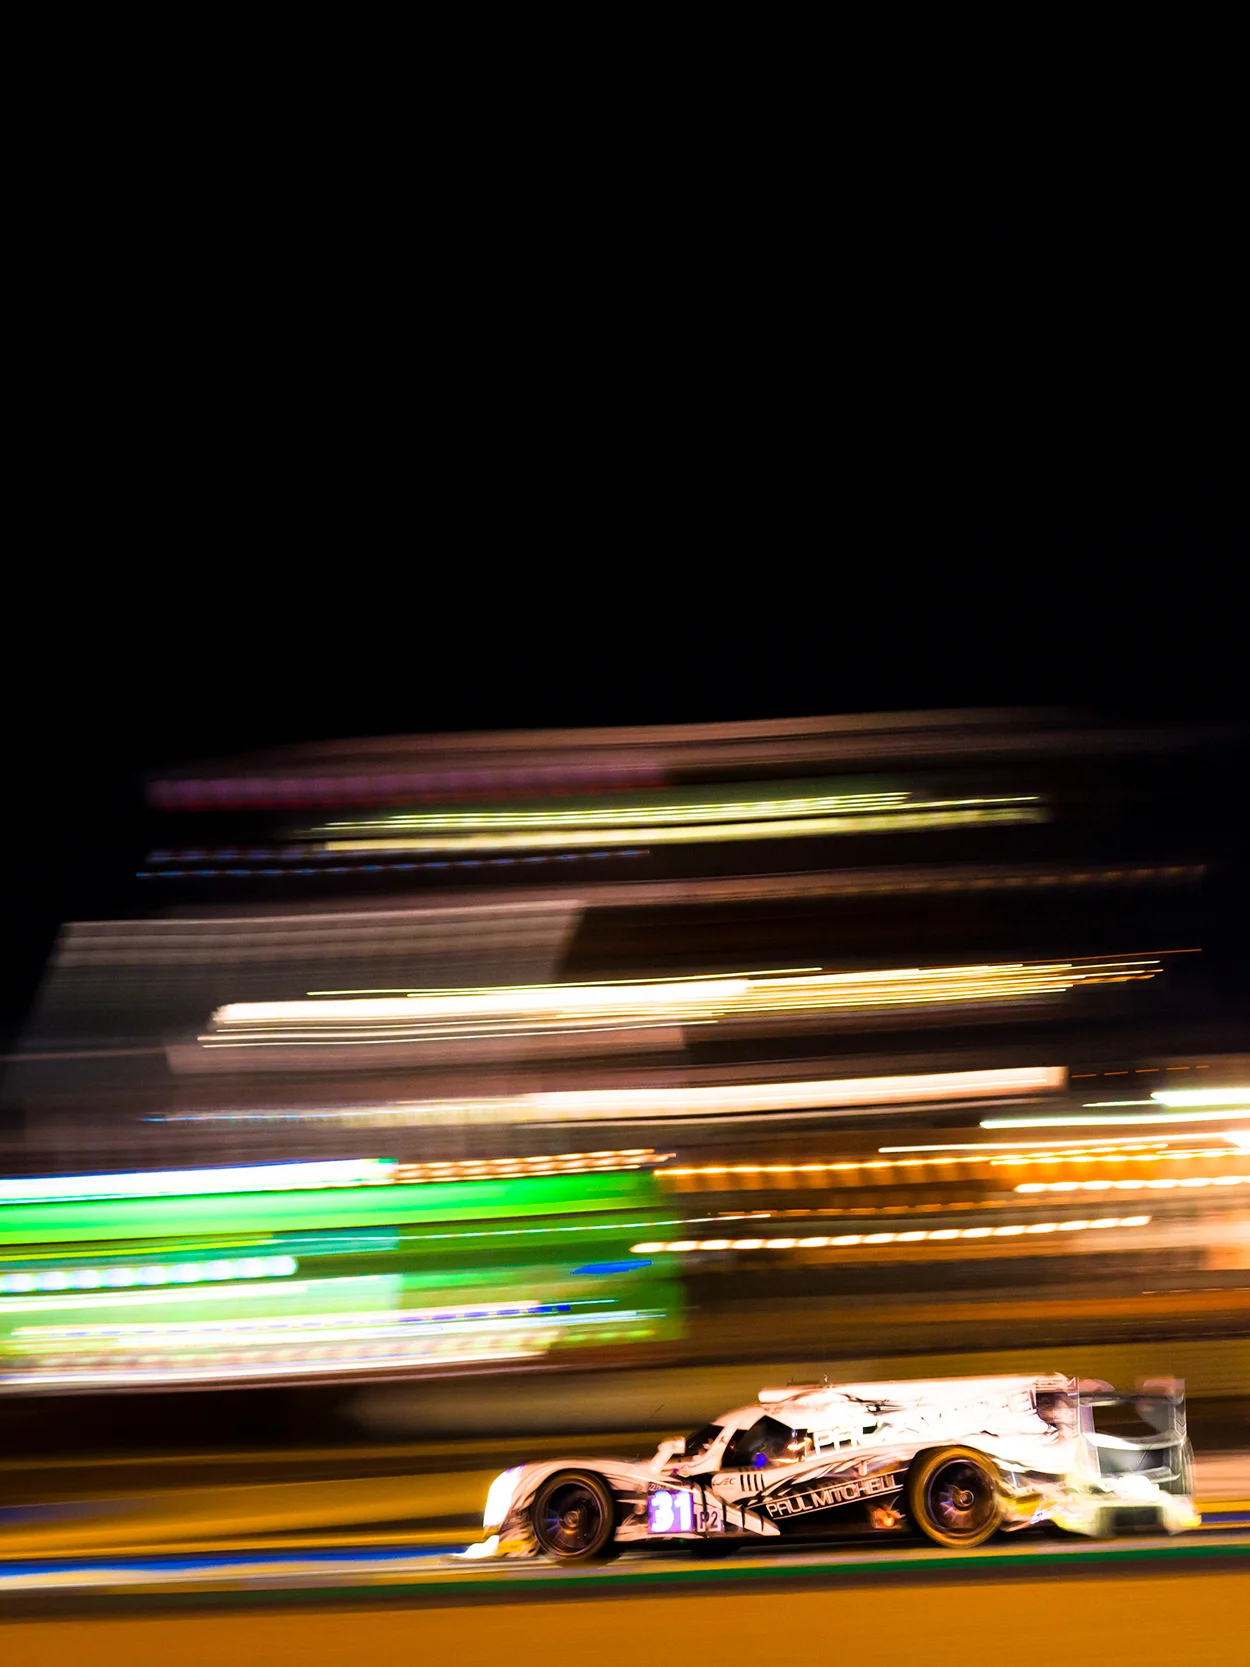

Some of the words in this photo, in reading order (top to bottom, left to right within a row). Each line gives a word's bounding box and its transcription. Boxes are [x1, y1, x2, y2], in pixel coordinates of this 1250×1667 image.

[651, 1490, 691, 1533] 31
[766, 1495, 813, 1517] PAUL
[810, 1474, 904, 1508] MITCHELL
[700, 1511, 718, 1529] P2
